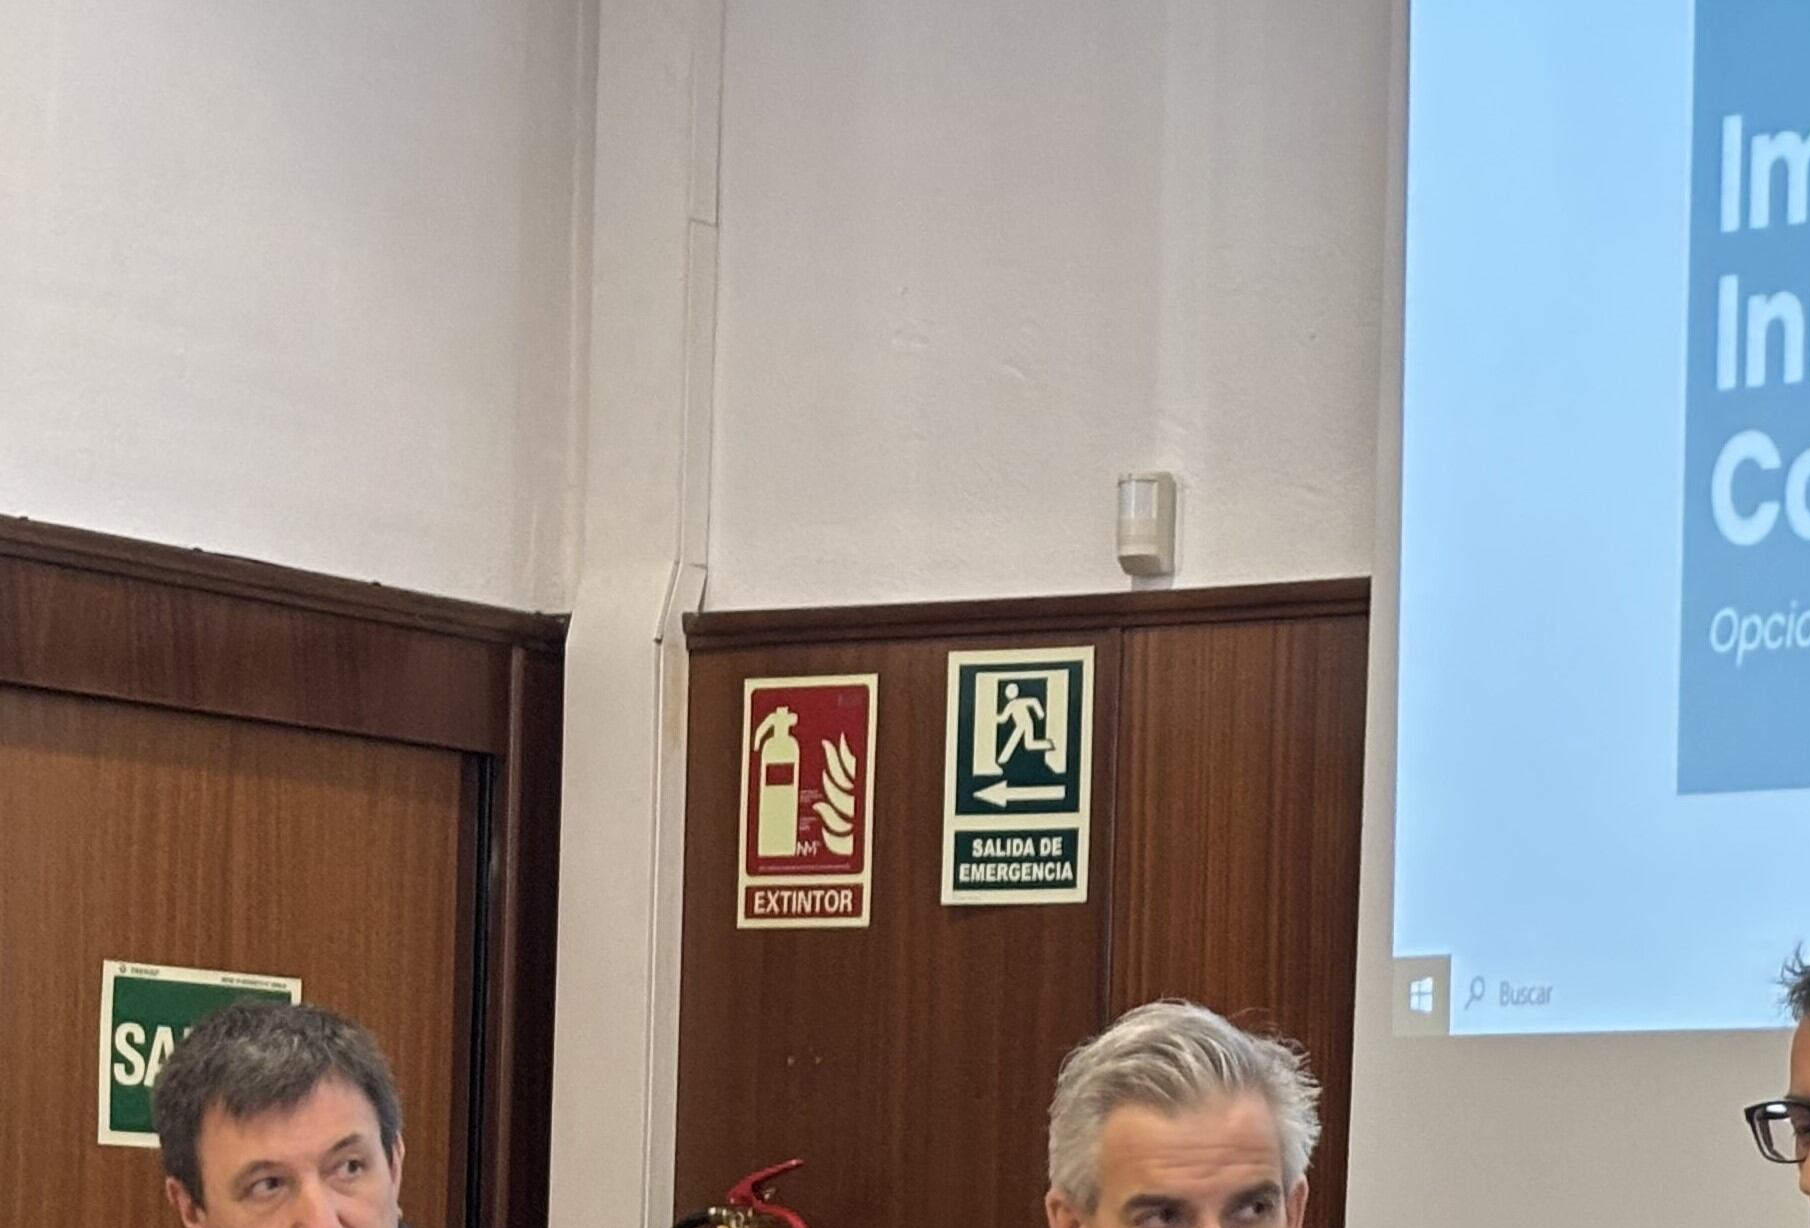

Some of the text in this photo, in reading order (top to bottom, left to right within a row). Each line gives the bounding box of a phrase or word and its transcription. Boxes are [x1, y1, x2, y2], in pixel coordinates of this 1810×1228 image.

[972, 837, 1063, 858] SALIDA DE
[959, 861, 1073, 883] EMERGENCIA
[754, 889, 853, 914] EXTINTOR
[1499, 981, 1552, 1007] Buscar
